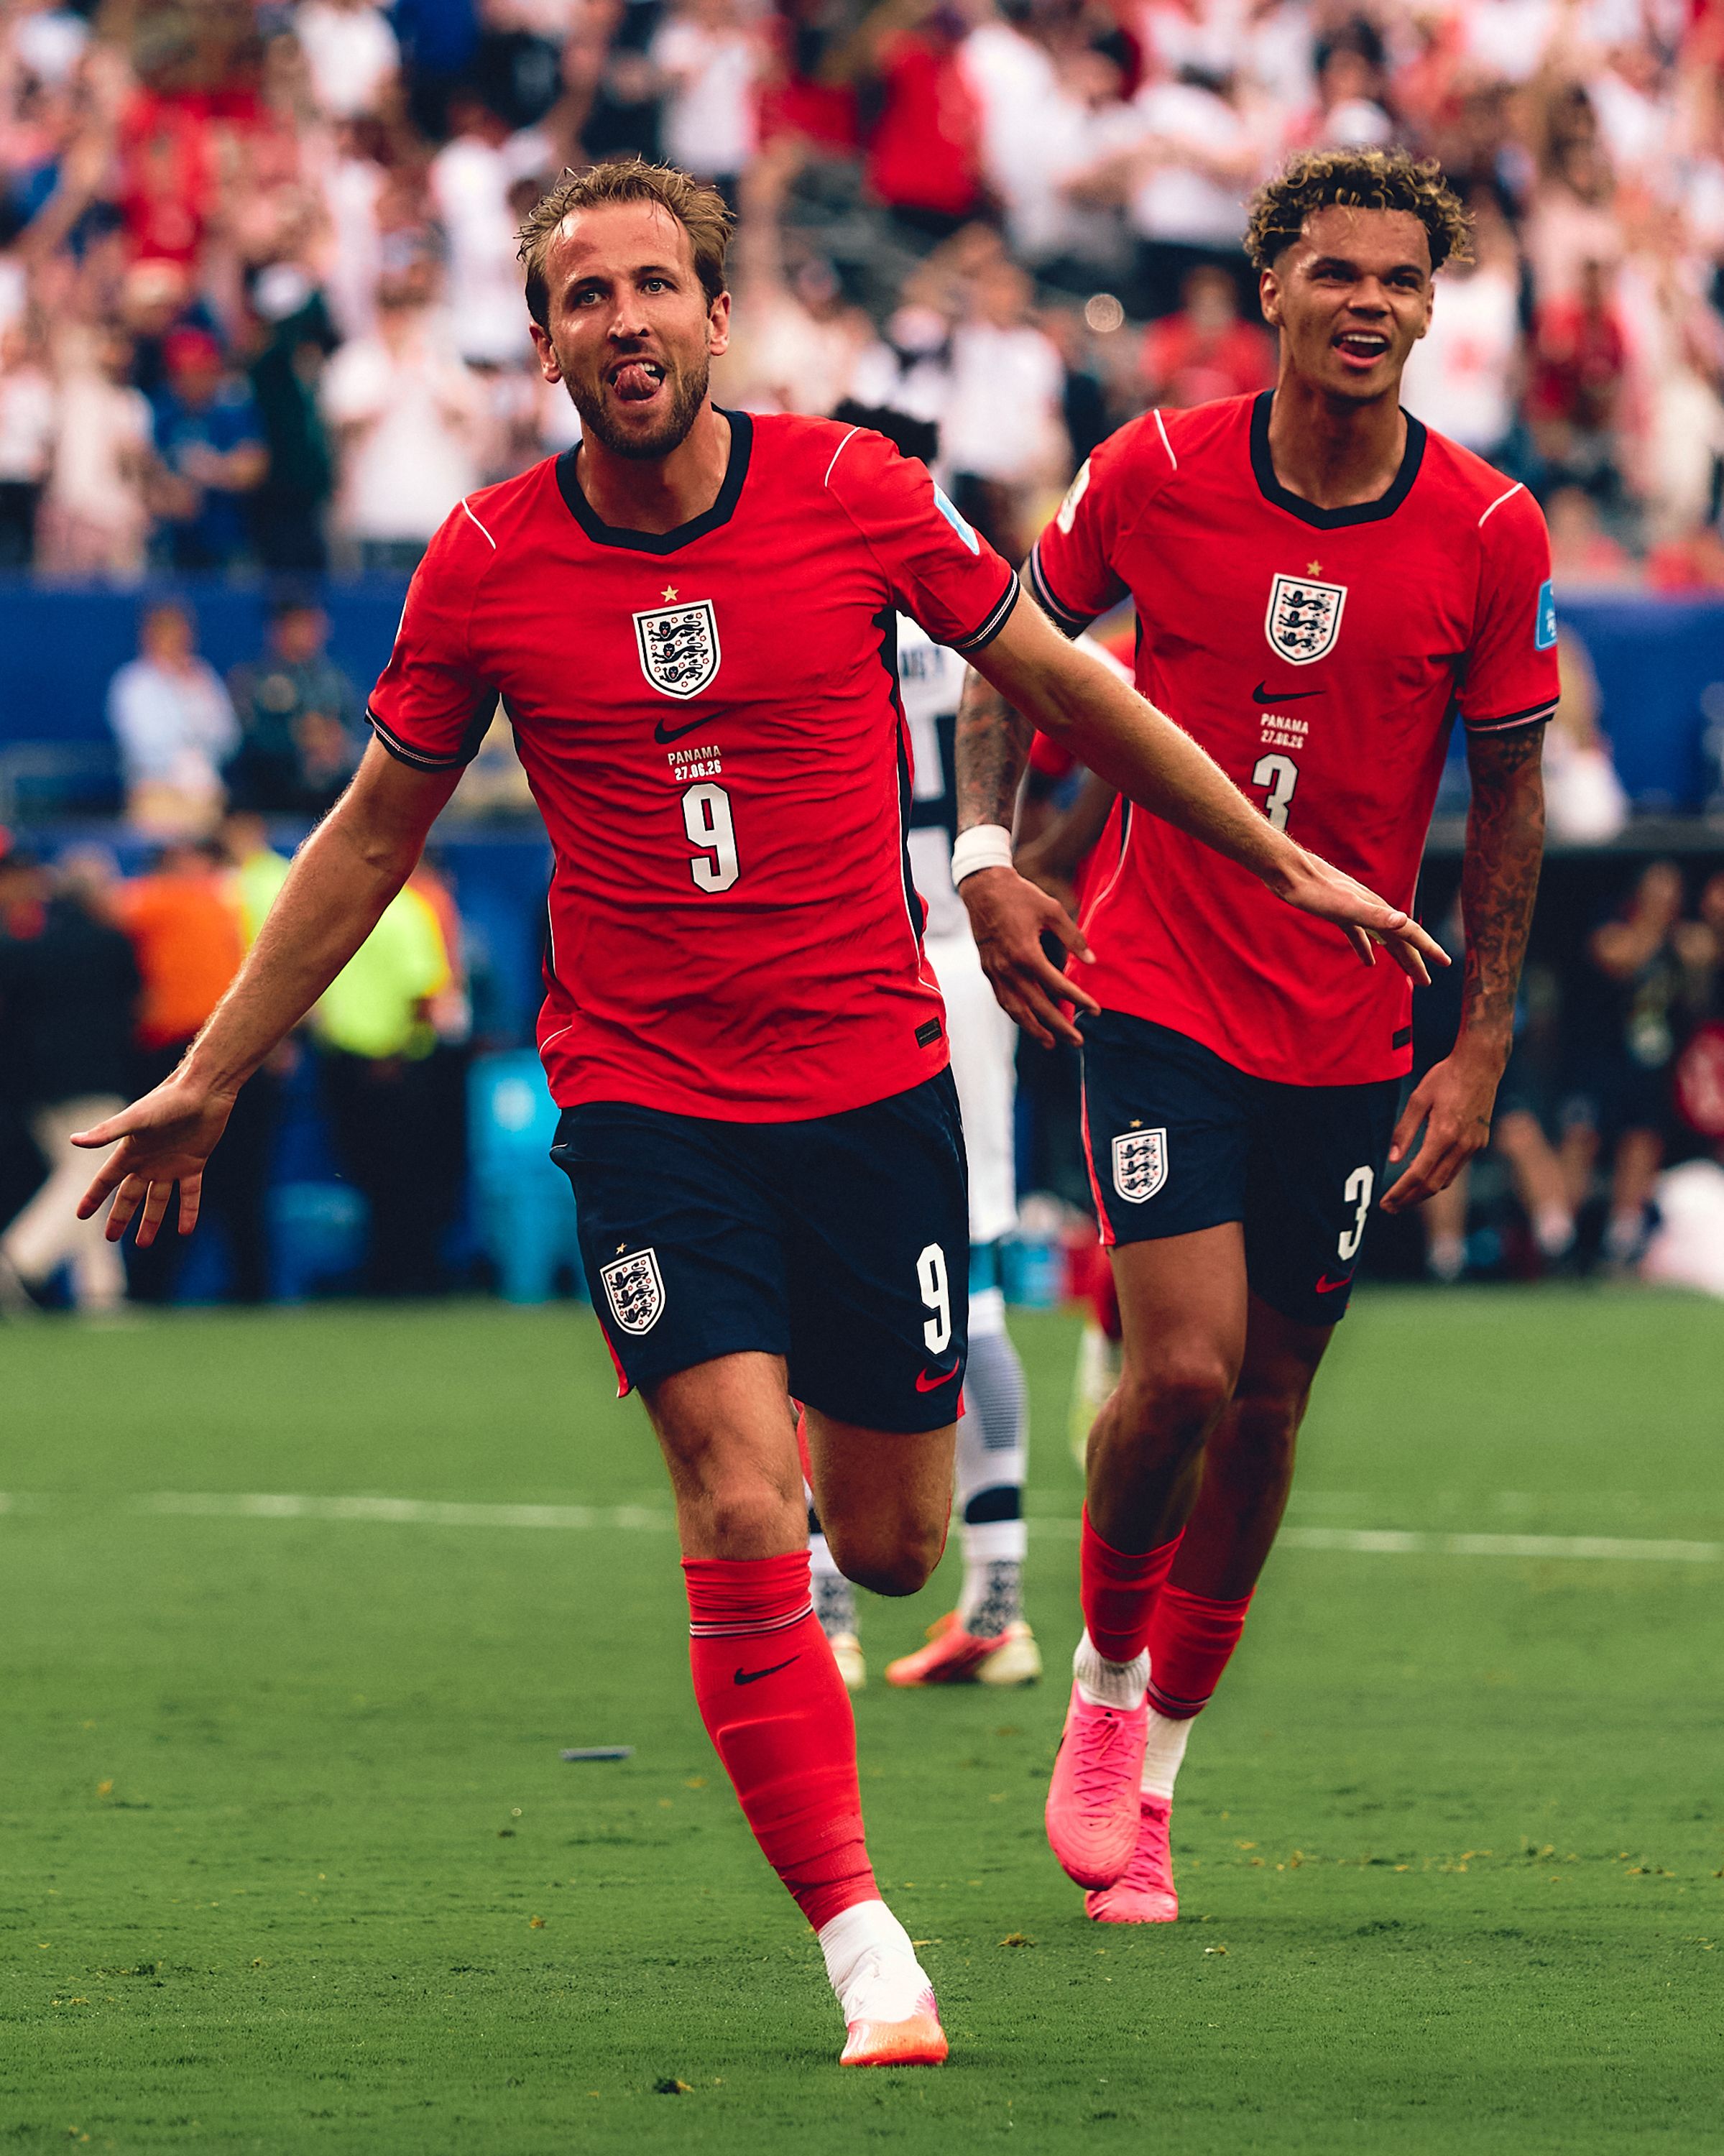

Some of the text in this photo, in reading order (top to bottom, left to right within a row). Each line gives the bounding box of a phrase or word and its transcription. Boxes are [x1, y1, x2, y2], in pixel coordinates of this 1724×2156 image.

[668, 745, 722, 765] PANAMA
[1260, 713, 1309, 734] PANAMA
[674, 760, 722, 781] 27.06.26
[1252, 753, 1299, 832] 3
[682, 782, 740, 893] 9
[1337, 1165, 1375, 1261] 3
[916, 1242, 952, 1355] 9
